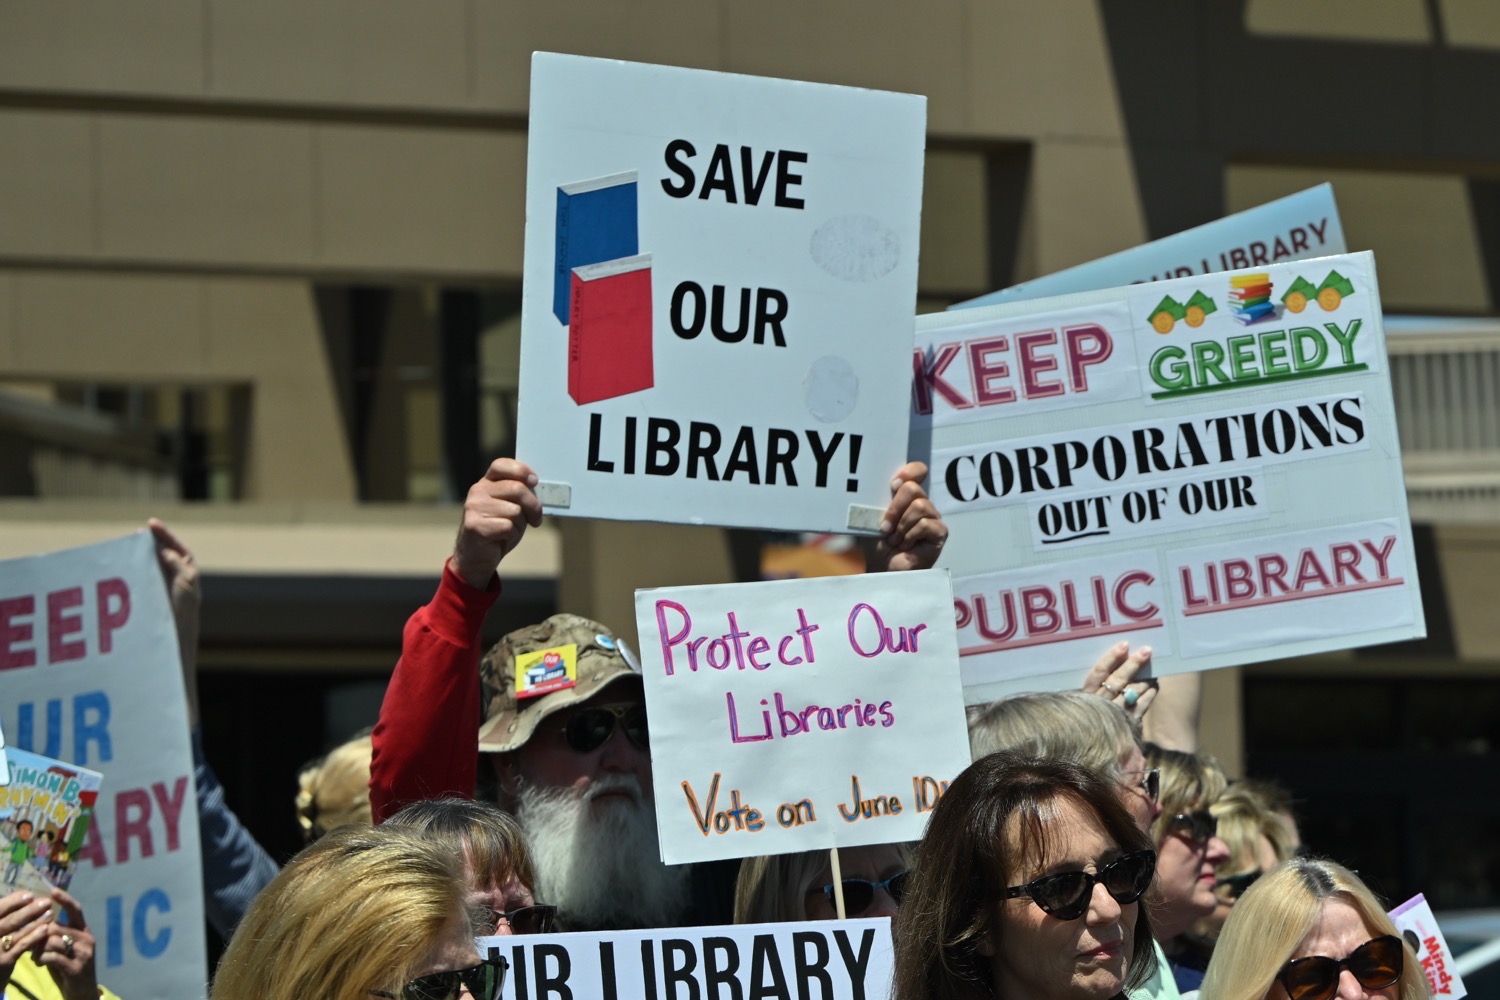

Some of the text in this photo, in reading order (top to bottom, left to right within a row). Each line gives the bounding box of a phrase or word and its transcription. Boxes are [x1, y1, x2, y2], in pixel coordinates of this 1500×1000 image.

[660, 139, 808, 210] SAVE
[670, 281, 789, 348] OUR
[913, 318, 1362, 416] KEEP GREEDY
[587, 413, 863, 493] LIBRARY!
[944, 397, 1365, 503] CORPORATIONS
[1037, 475, 1257, 537] OUT OF OUR
[1180, 535, 1397, 610] LIBRARY
[655, 600, 928, 676] Protect Our
[725, 691, 895, 744] Libraries
[682, 772, 765, 837] Vote
[776, 797, 816, 829] on
[837, 775, 902, 823] June
